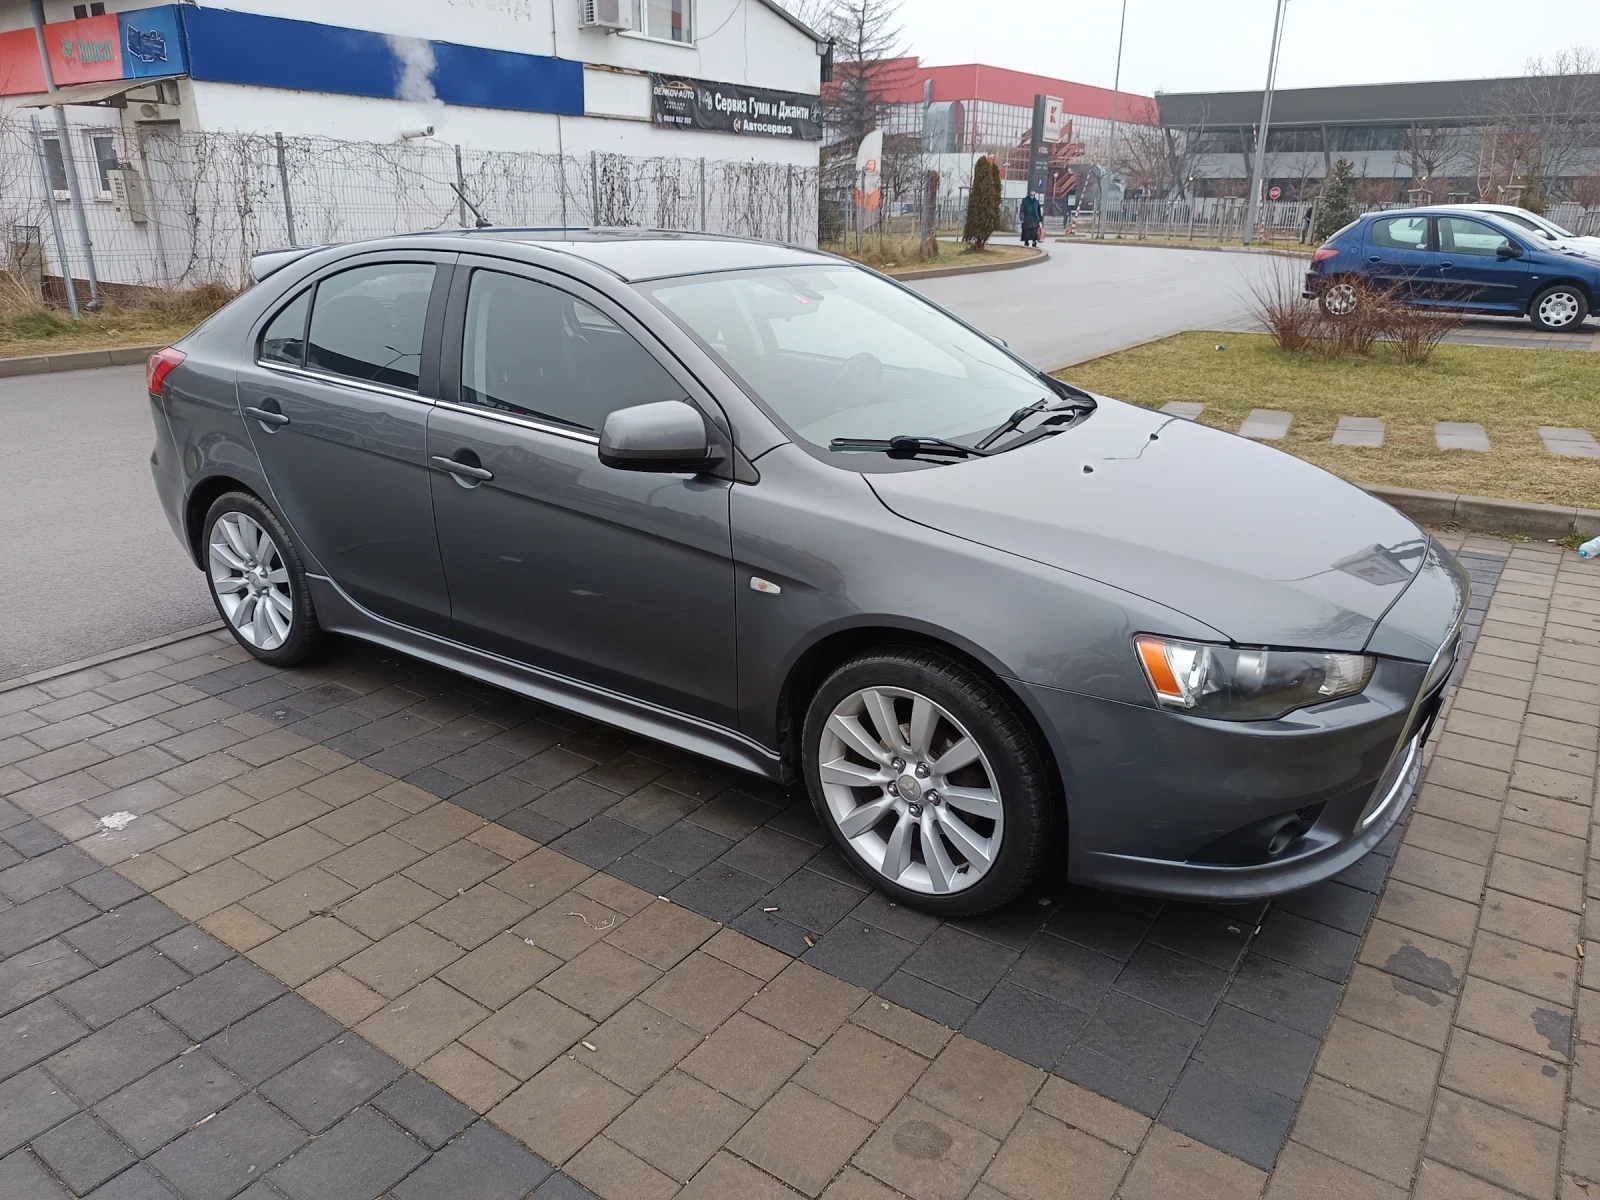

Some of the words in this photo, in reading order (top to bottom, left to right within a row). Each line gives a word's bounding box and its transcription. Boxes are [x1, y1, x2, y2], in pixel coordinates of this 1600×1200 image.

[77, 38, 116, 63] Bobcat
[715, 92, 747, 116] Сервиз
[749, 96, 770, 119] Гуми
[772, 106, 777, 116] и
[778, 100, 809, 121] Джанти
[1050, 106, 1057, 124] K
[743, 119, 793, 135] Автосервиз
